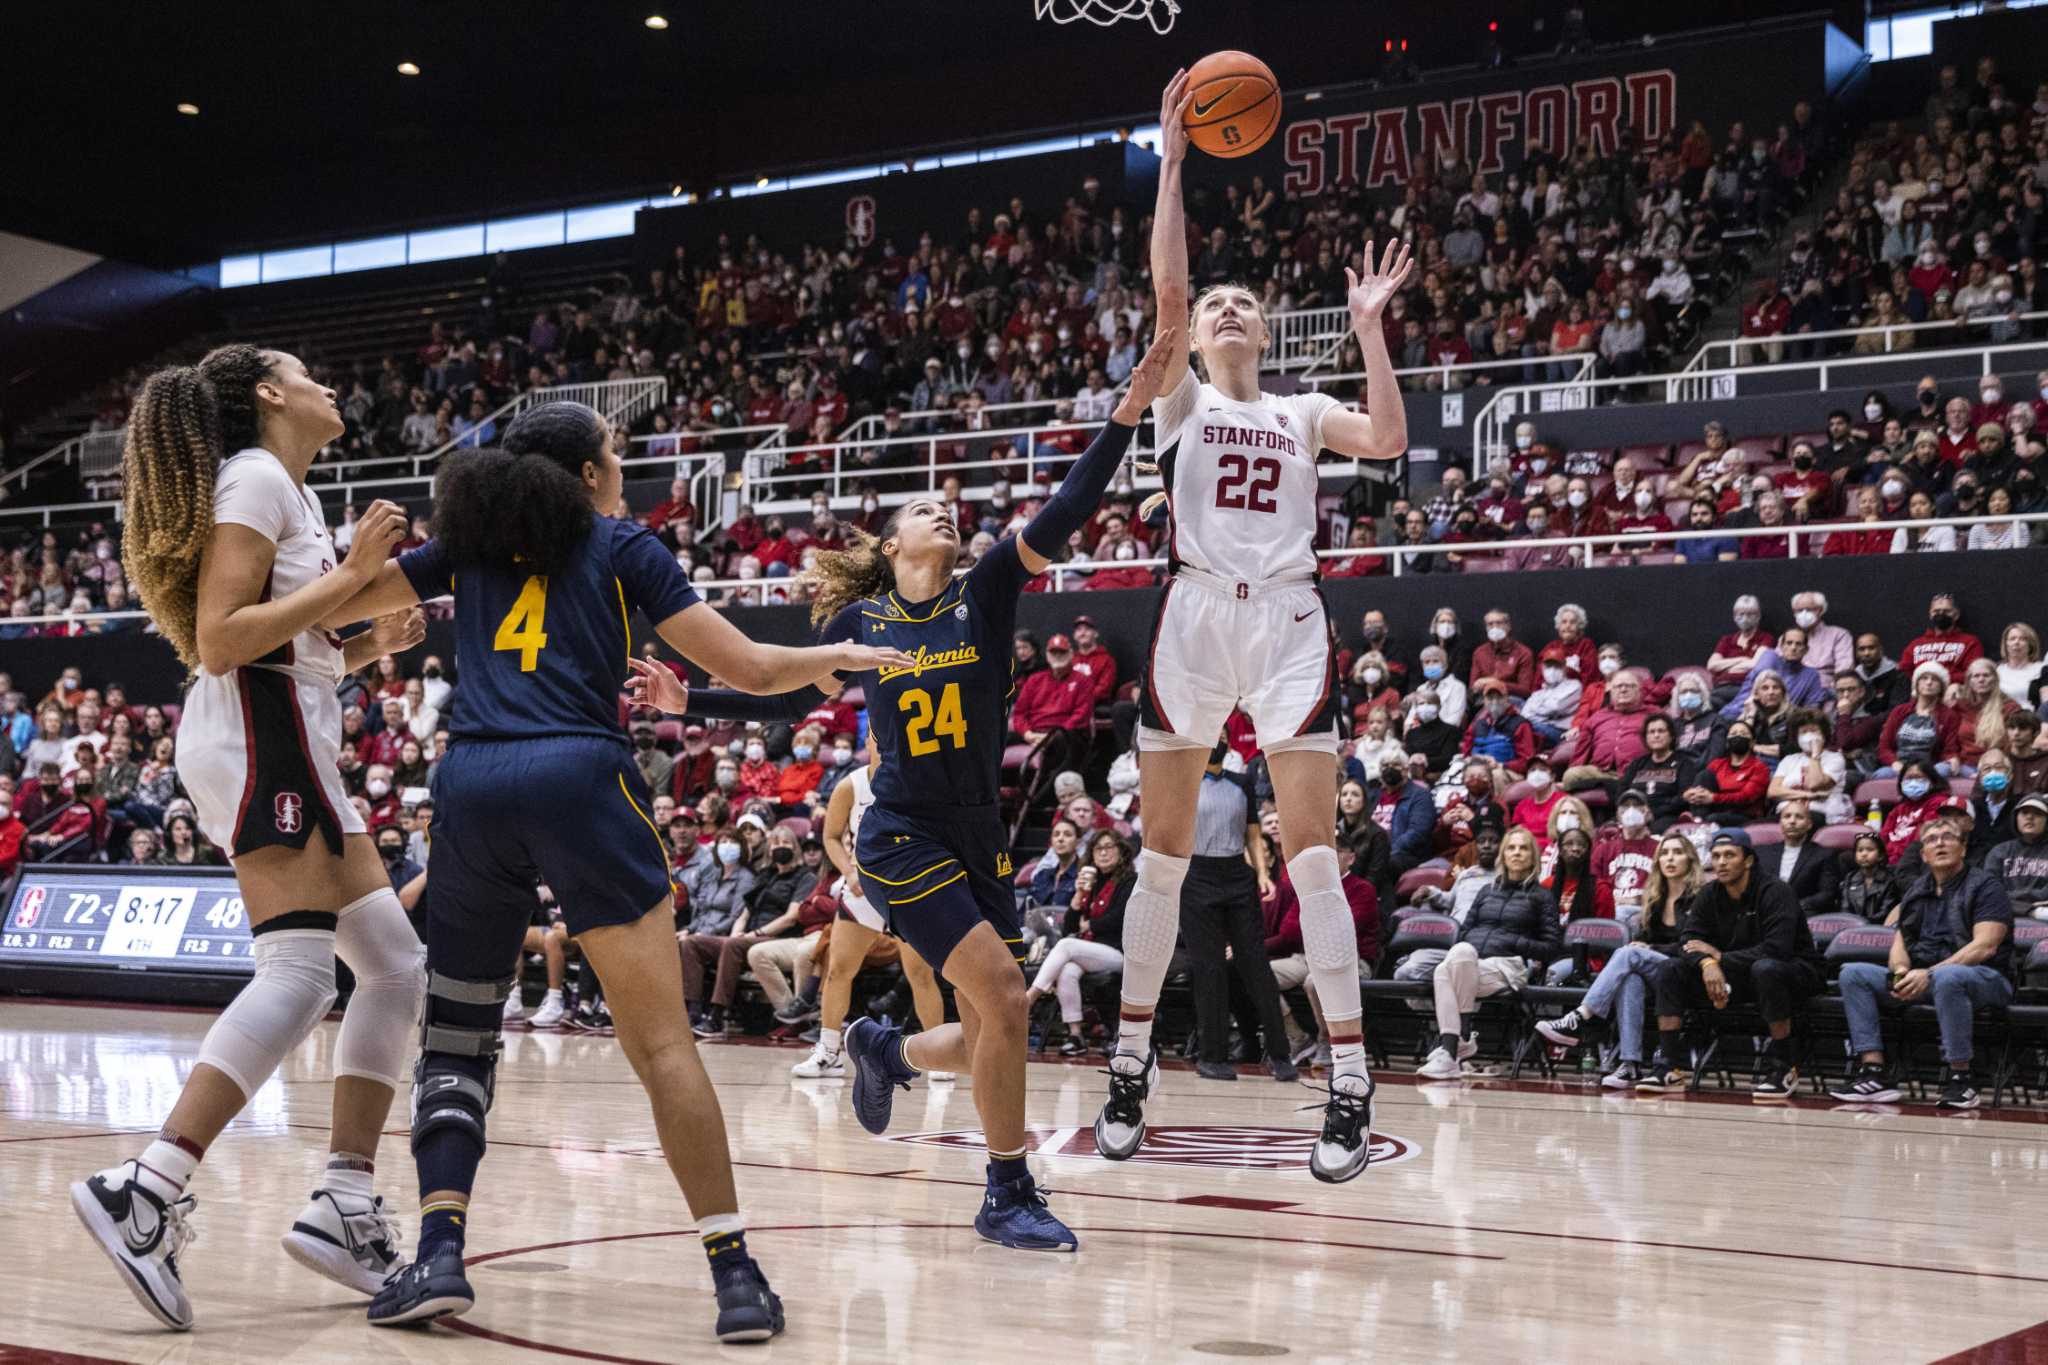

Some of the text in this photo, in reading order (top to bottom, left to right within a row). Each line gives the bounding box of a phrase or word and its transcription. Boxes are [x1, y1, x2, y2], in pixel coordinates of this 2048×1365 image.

[1284, 69, 1676, 197] STANFORD
[1203, 425, 1296, 456] STANFORD
[1216, 454, 1282, 514] 22
[494, 575, 549, 672] 4
[898, 683, 967, 757] 24
[63, 893, 101, 924] 72
[124, 897, 182, 925] 8:17
[205, 897, 244, 928] 48
[48, 935, 73, 949] FLS
[184, 939, 210, 953] FLS
